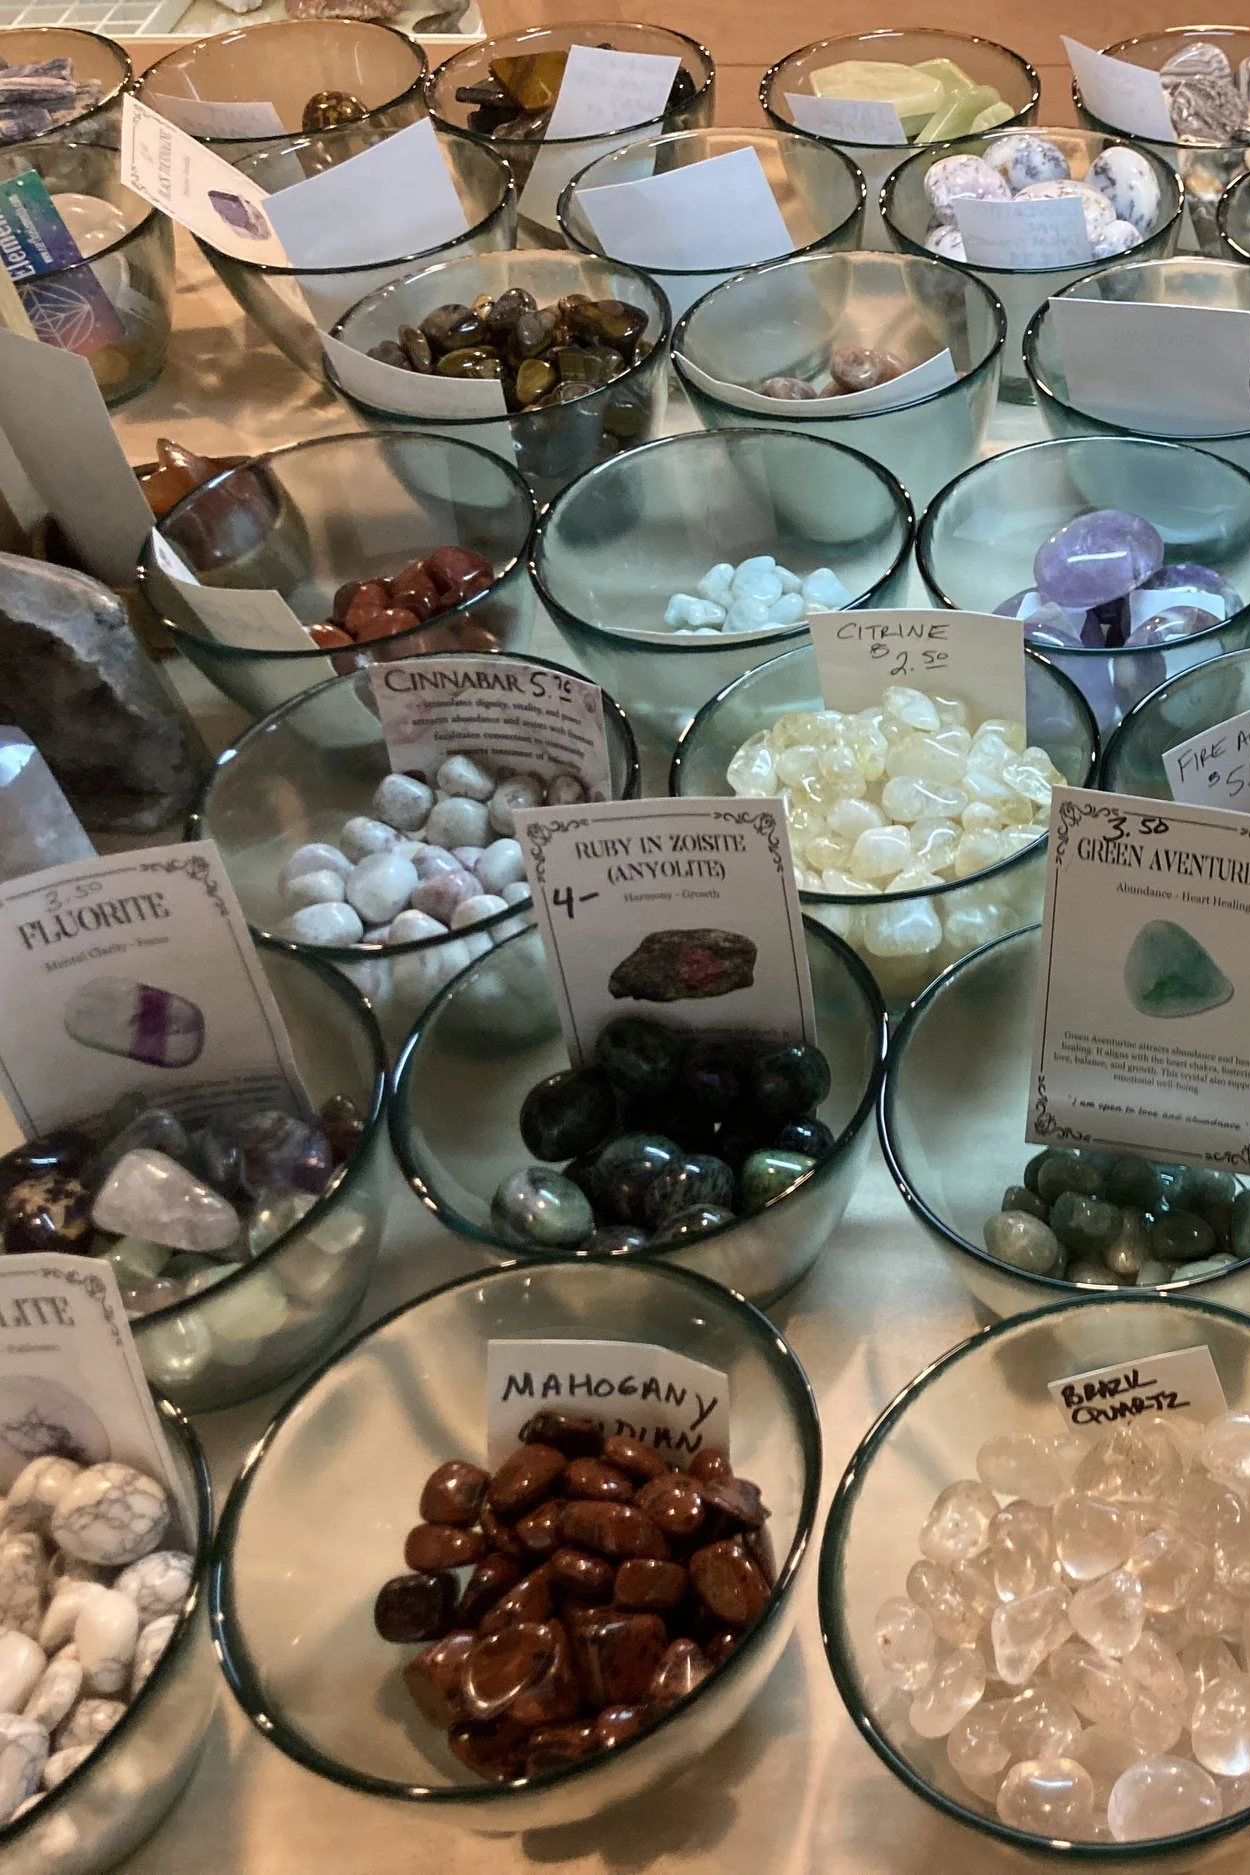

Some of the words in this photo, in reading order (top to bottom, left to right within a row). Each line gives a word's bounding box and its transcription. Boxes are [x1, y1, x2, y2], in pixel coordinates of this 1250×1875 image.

[836, 623, 950, 641] CITRINE
[384, 669, 524, 693] CINNABAR
[1177, 737, 1227, 782] FIRE
[1101, 816, 1170, 842] 3.50
[575, 837, 631, 860] RUBY
[640, 834, 664, 853] IN
[670, 833, 747, 852] ZOISITE
[1077, 836, 1144, 868] GREEN
[607, 859, 726, 885] (ANYOLITE)
[624, 891, 672, 904] Harmony
[682, 888, 720, 900] Growth
[1116, 881, 1173, 900] Abundance
[1182, 891, 1210, 905] Heart
[1213, 895, 1250, 914] Healing
[16, 891, 172, 950] FLUORITE
[502, 1371, 719, 1432] MAHOGANY
[1071, 1390, 1191, 1425] QUARTZ
